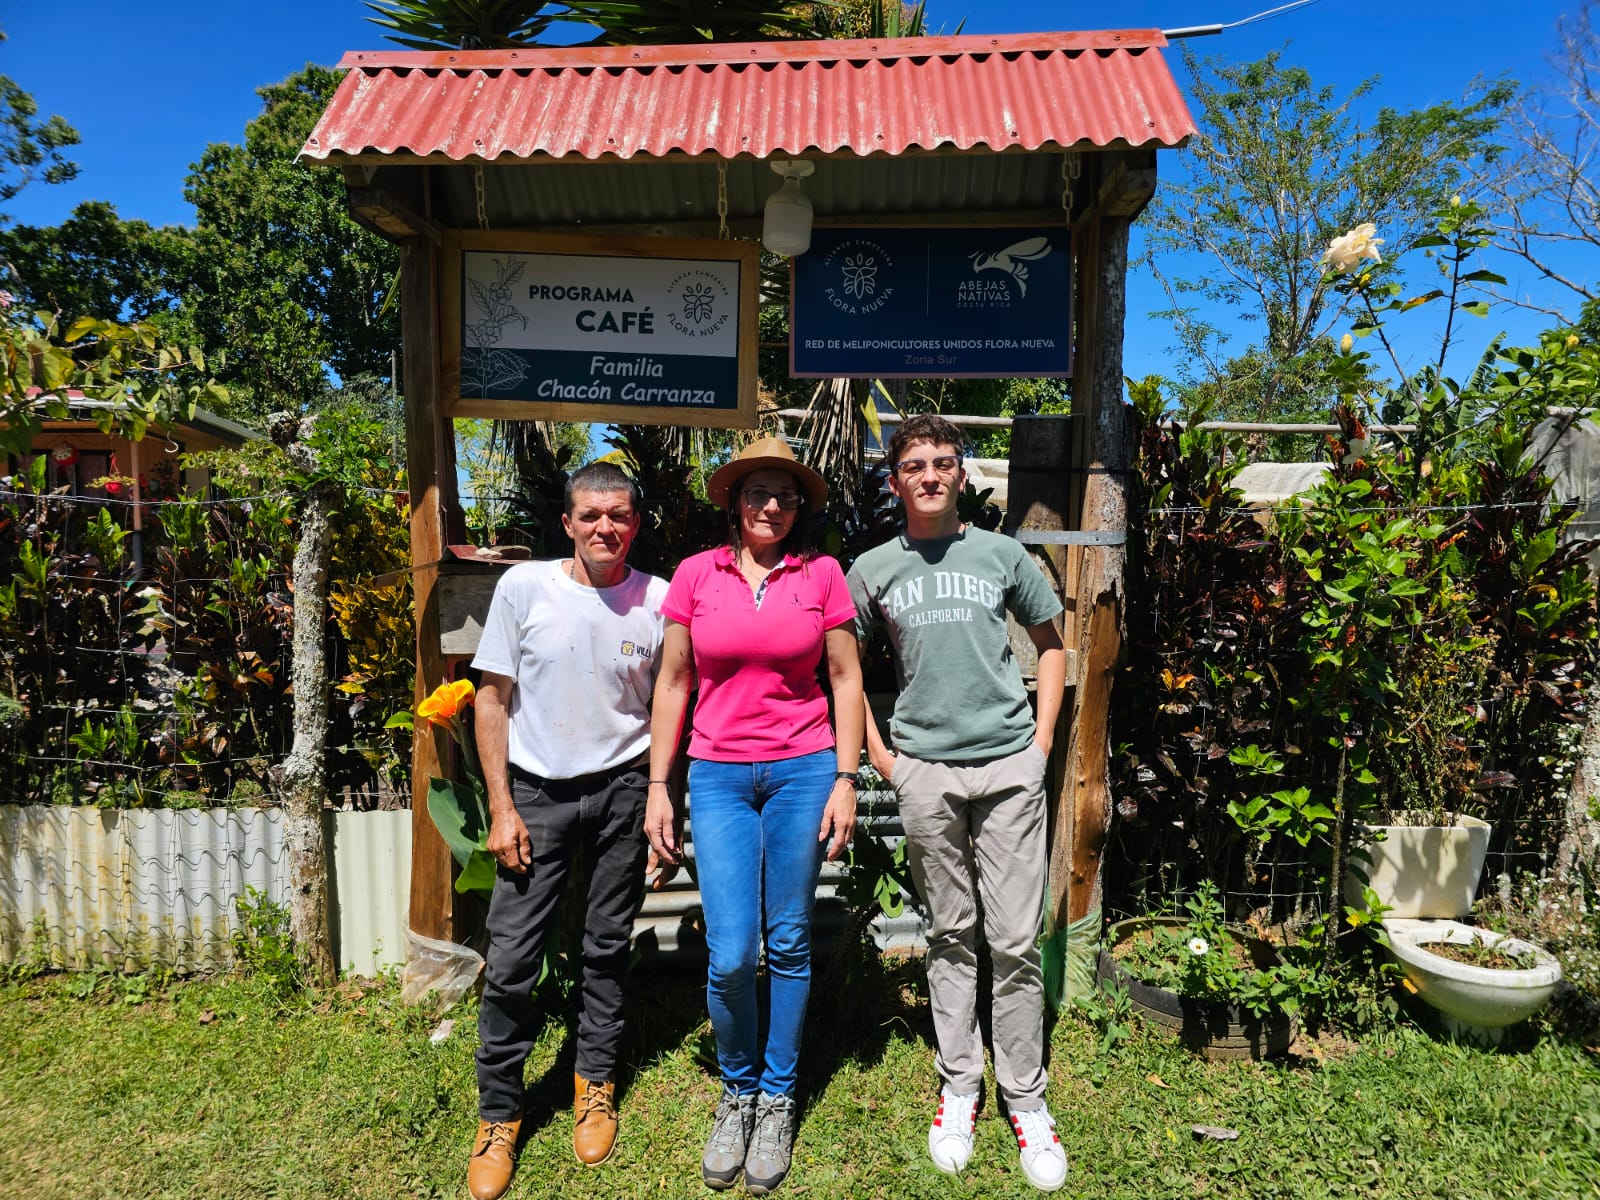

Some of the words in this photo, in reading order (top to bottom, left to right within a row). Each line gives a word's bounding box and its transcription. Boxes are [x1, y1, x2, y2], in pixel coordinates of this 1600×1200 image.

[528, 284, 635, 303] PROGRAMA
[958, 280, 1007, 290] ABEJAS
[824, 288, 856, 315] FLORA
[861, 288, 894, 315] NUEVA
[958, 291, 1011, 301] NATIVAS
[575, 306, 655, 335] CAFÉ
[666, 312, 695, 337] FLORA
[700, 314, 729, 337] NUEVA
[804, 339, 825, 349] RED
[827, 339, 841, 349] DE
[843, 340, 941, 350] MELIPONICULTORES
[943, 339, 983, 349] UNIDOS
[985, 339, 1019, 349] FLORA
[1021, 339, 1056, 348] NUEVA
[590, 355, 664, 378] Familia
[904, 354, 934, 365] Zona
[937, 354, 959, 365] Sur
[537, 378, 612, 401] Chacón
[620, 382, 716, 404] Carranza
[908, 608, 973, 627] CALIFORNIA
